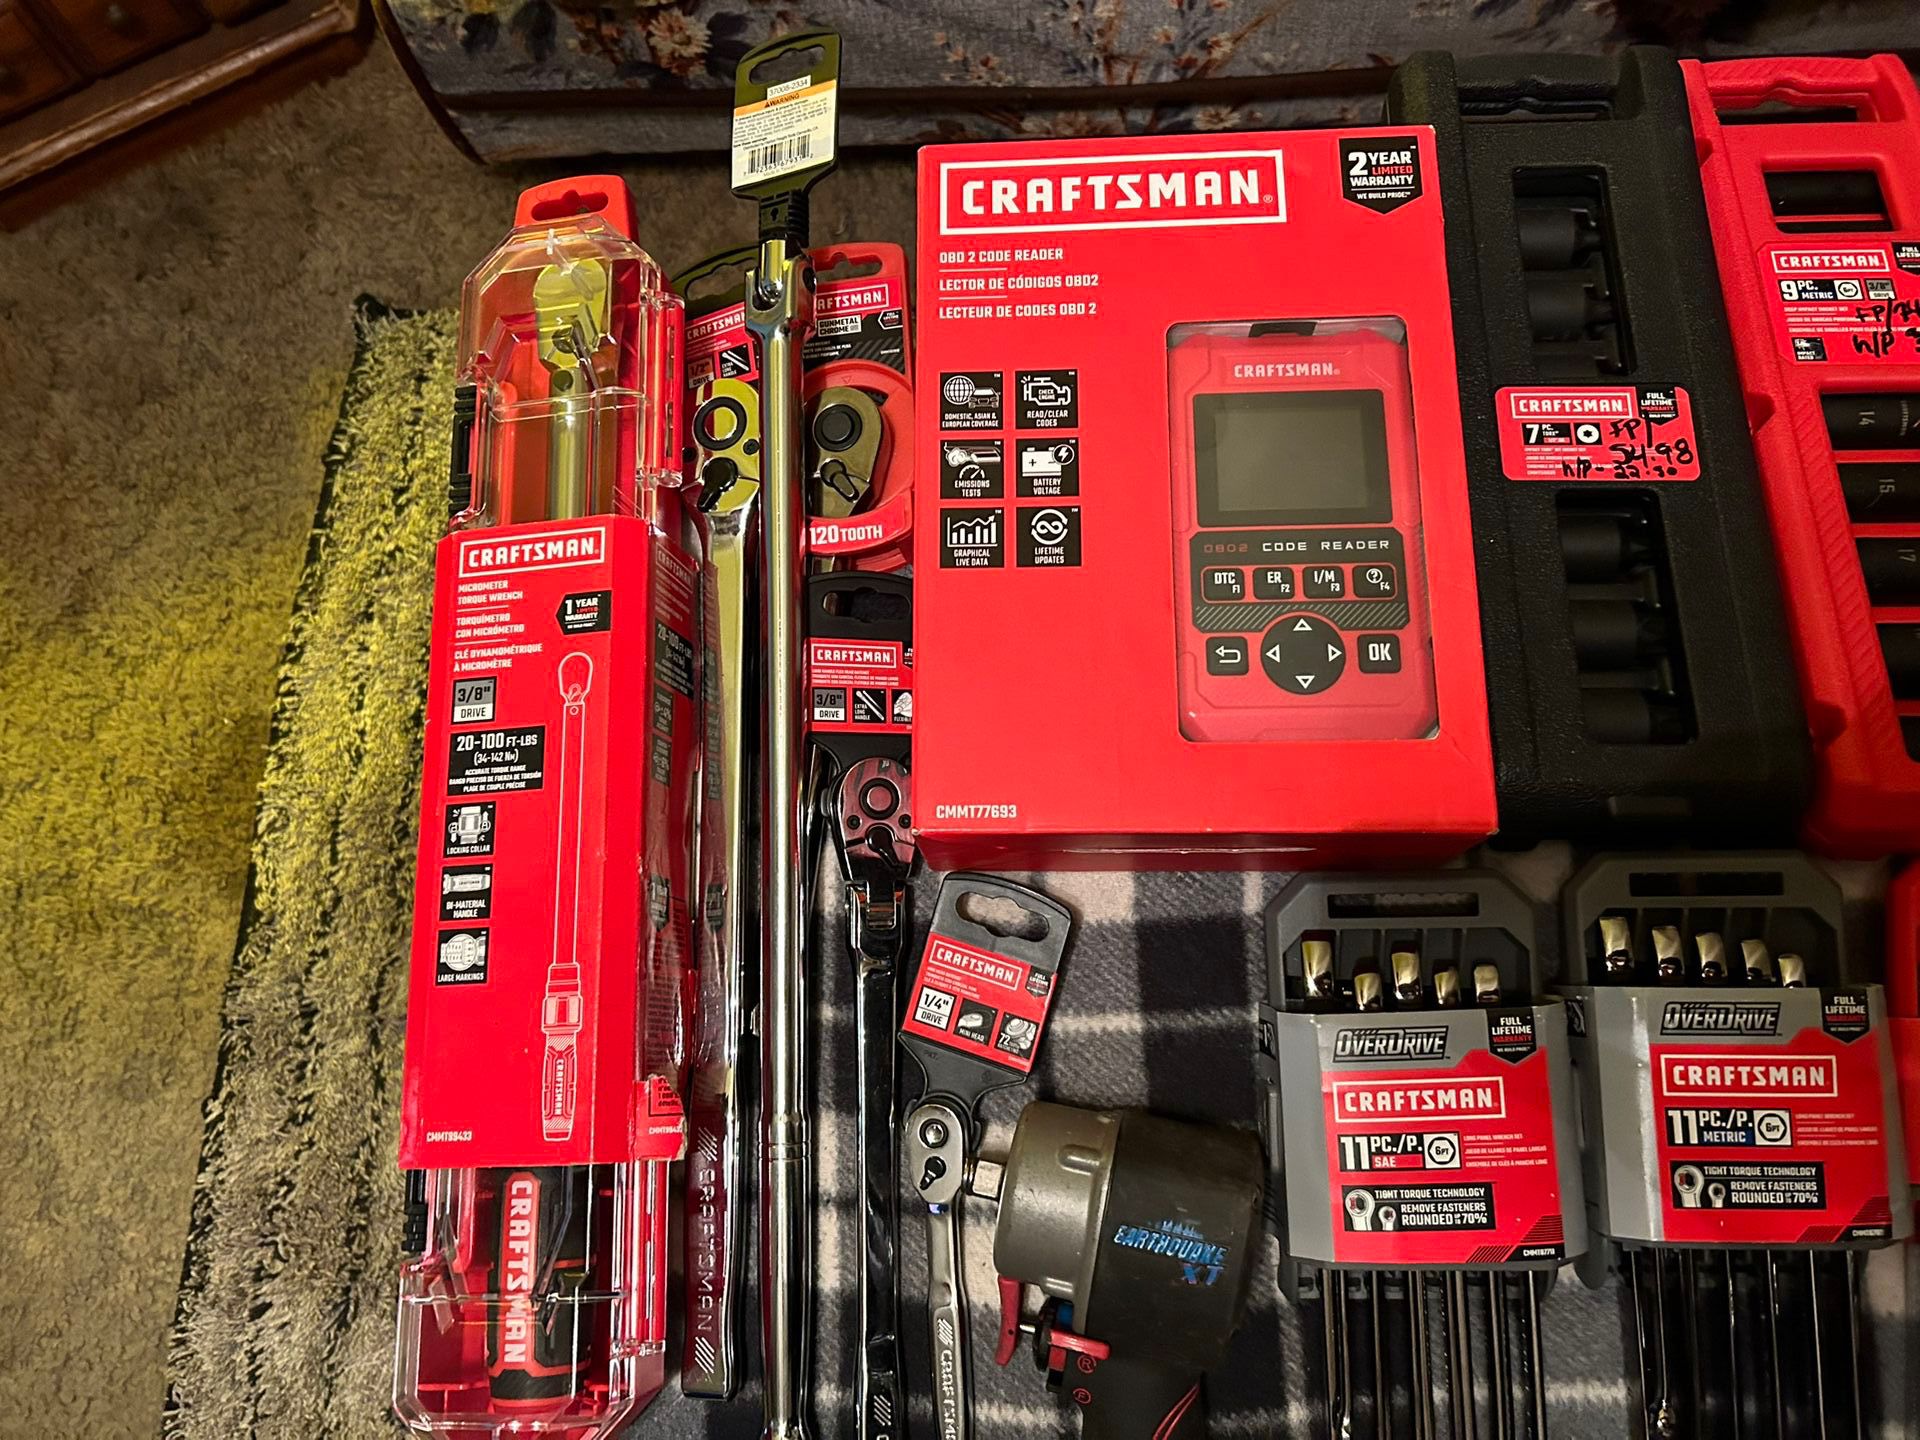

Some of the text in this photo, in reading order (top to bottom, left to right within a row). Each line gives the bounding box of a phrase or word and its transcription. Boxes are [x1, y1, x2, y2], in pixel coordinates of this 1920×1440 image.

[1348, 151, 1411, 176] 2 YEAR
[1372, 165, 1413, 175] LIMITED
[1350, 175, 1414, 187] WARRANTY
[963, 169, 1259, 215] CRAFTSMAN
[940, 248, 1063, 263] OBD 2 CODE READER
[1779, 255, 1880, 268] CRAFTSMAN
[939, 272, 1098, 291] LECTOR DE CÓDIGOS OBD2
[1780, 280, 1818, 300] 9 PC.
[817, 290, 882, 310] AFTSMAN
[939, 303, 1096, 319] LECTEUR DE CODES OBD 2
[820, 326, 849, 335] CHROME
[1234, 363, 1332, 378] CRAFTSMAN
[1518, 399, 1623, 413] CRAFTSMAN
[1027, 410, 1068, 418] READ/CLEAR
[942, 420, 970, 428] EUROPEAN
[1036, 419, 1057, 427] CODES
[1525, 424, 1540, 444] 7
[954, 480, 990, 488] EMISSIONS
[1033, 478, 1061, 486] BATTERY
[962, 489, 981, 497] TESTS
[1033, 487, 1061, 495] VOLTAGE
[809, 524, 883, 545] 120 TOOTH
[1034, 547, 1064, 555] LIFETIME
[1262, 541, 1307, 552] CODE
[1320, 539, 1390, 551] READER
[469, 537, 596, 568] CRAFTSMAN
[953, 549, 990, 557] GRAPHICAL
[956, 558, 989, 566] LIVE DATA
[1035, 556, 1065, 564] UPDATES
[1214, 572, 1236, 585] DTC
[1267, 571, 1282, 584] ER
[458, 580, 508, 593] MICROMETER
[1281, 583, 1290, 593] F2
[1331, 582, 1340, 592] F3
[1381, 581, 1390, 591] F4
[458, 590, 523, 605] TORQUE WRENCH
[565, 597, 598, 615] 1 YEAR
[455, 628, 472, 639] CON
[817, 649, 891, 663] CRAFTSMAN
[1368, 643, 1392, 661] OK
[458, 685, 491, 702] 3/8"
[460, 707, 486, 719] DRIVE
[819, 710, 840, 719] DRIVE
[456, 732, 537, 752] 20-100 FT-LBS
[936, 804, 1017, 818] CMMT77693
[446, 844, 490, 855] LOCKING COLLAR
[446, 899, 486, 910] BI-MATERIAL
[453, 908, 478, 918] HANDLE
[936, 948, 1014, 983] CRAFTSMAN
[437, 972, 484, 983] LARGE MARKINGS
[1834, 996, 1856, 1005] FULL
[1825, 1005, 1866, 1014] LIFETIME
[920, 1011, 943, 1025] DRIVE
[1500, 1016, 1522, 1026] FULL
[1491, 1025, 1532, 1035] LIFETIME
[999, 1032, 1011, 1046] 72
[1673, 1065, 1825, 1086] CRAFTSMAN
[554, 1058, 563, 1116] CRAFTSMAN
[1344, 1088, 1493, 1112] CRAFTSMAN
[1667, 1110, 1699, 1144] 11
[1703, 1131, 1746, 1143] METRIC
[1340, 1136, 1370, 1170] 11
[1374, 1156, 1396, 1168] SAE
[1704, 1166, 1816, 1176] TIGHT TORQUE TECHNOLOGY
[1730, 1181, 1817, 1191] REMOVE FASTENERS
[1374, 1187, 1485, 1200] TIGHT TORQUE TECHNOLOGY
[1731, 1193, 1784, 1204] ROUNDED
[1401, 1202, 1486, 1214] REMOVE FASTENERS
[1401, 1213, 1453, 1226] ROUNDED
[504, 1179, 533, 1364] CRAFTSMAN
